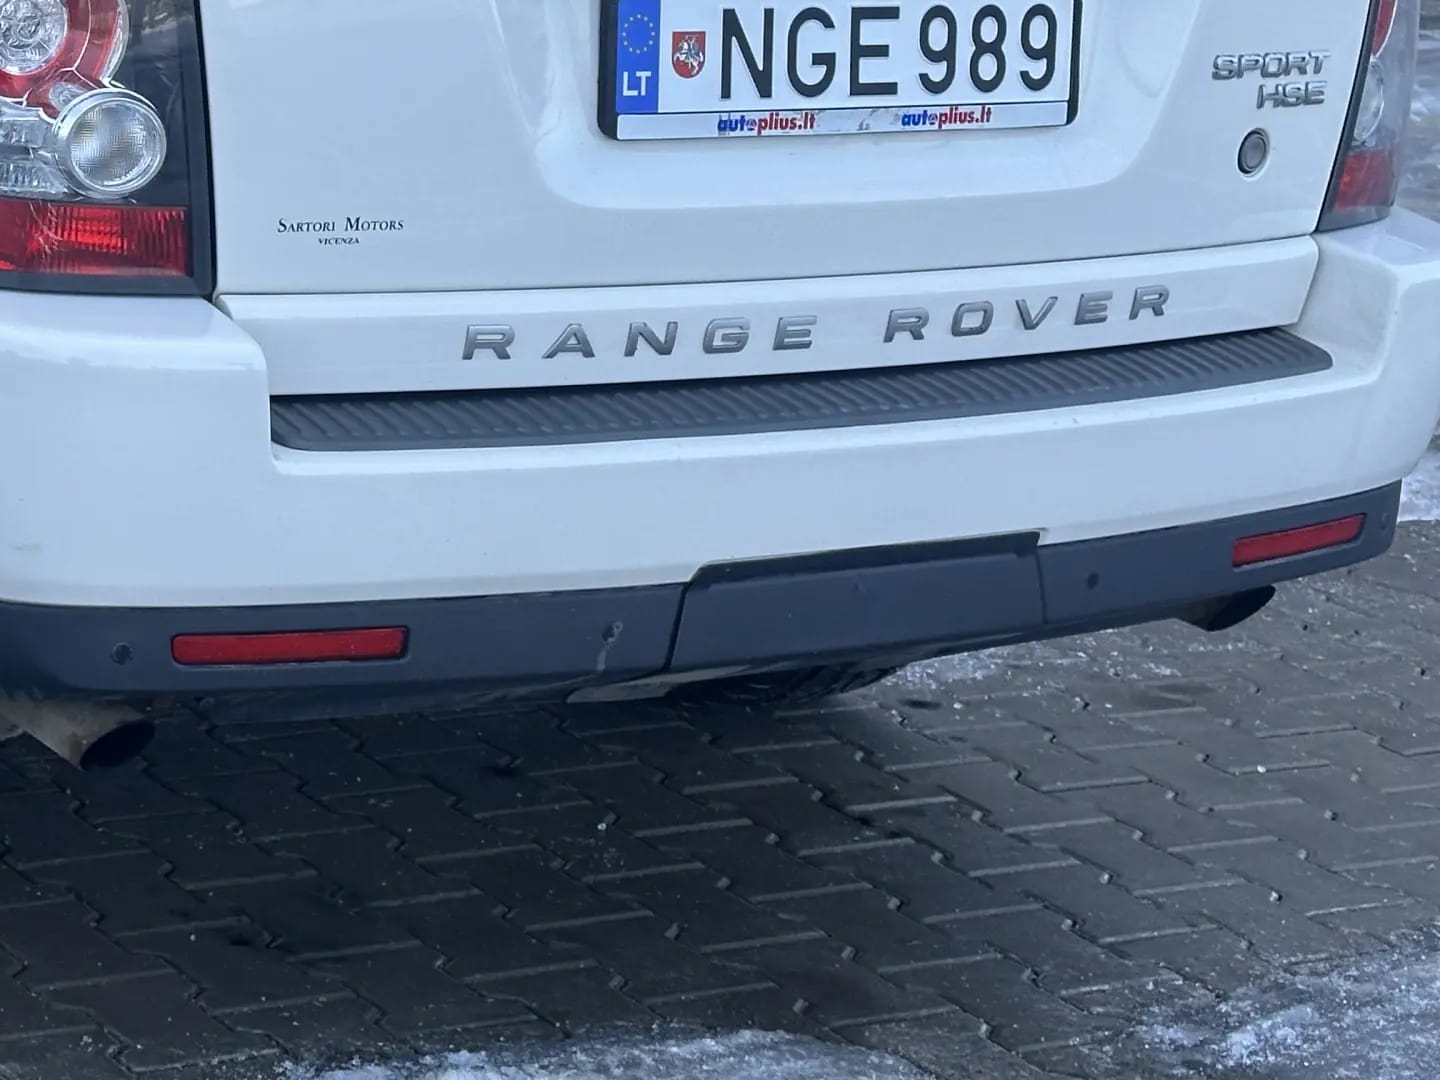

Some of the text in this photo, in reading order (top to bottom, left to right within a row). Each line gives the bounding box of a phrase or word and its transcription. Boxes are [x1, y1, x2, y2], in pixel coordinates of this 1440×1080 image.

[1212, 49, 1331, 80] SPORT
[622, 70, 652, 97] LT
[1256, 81, 1327, 110] HSE
[318, 237, 360, 246] VICENZA
[461, 284, 1170, 361] RANGE ROVER
